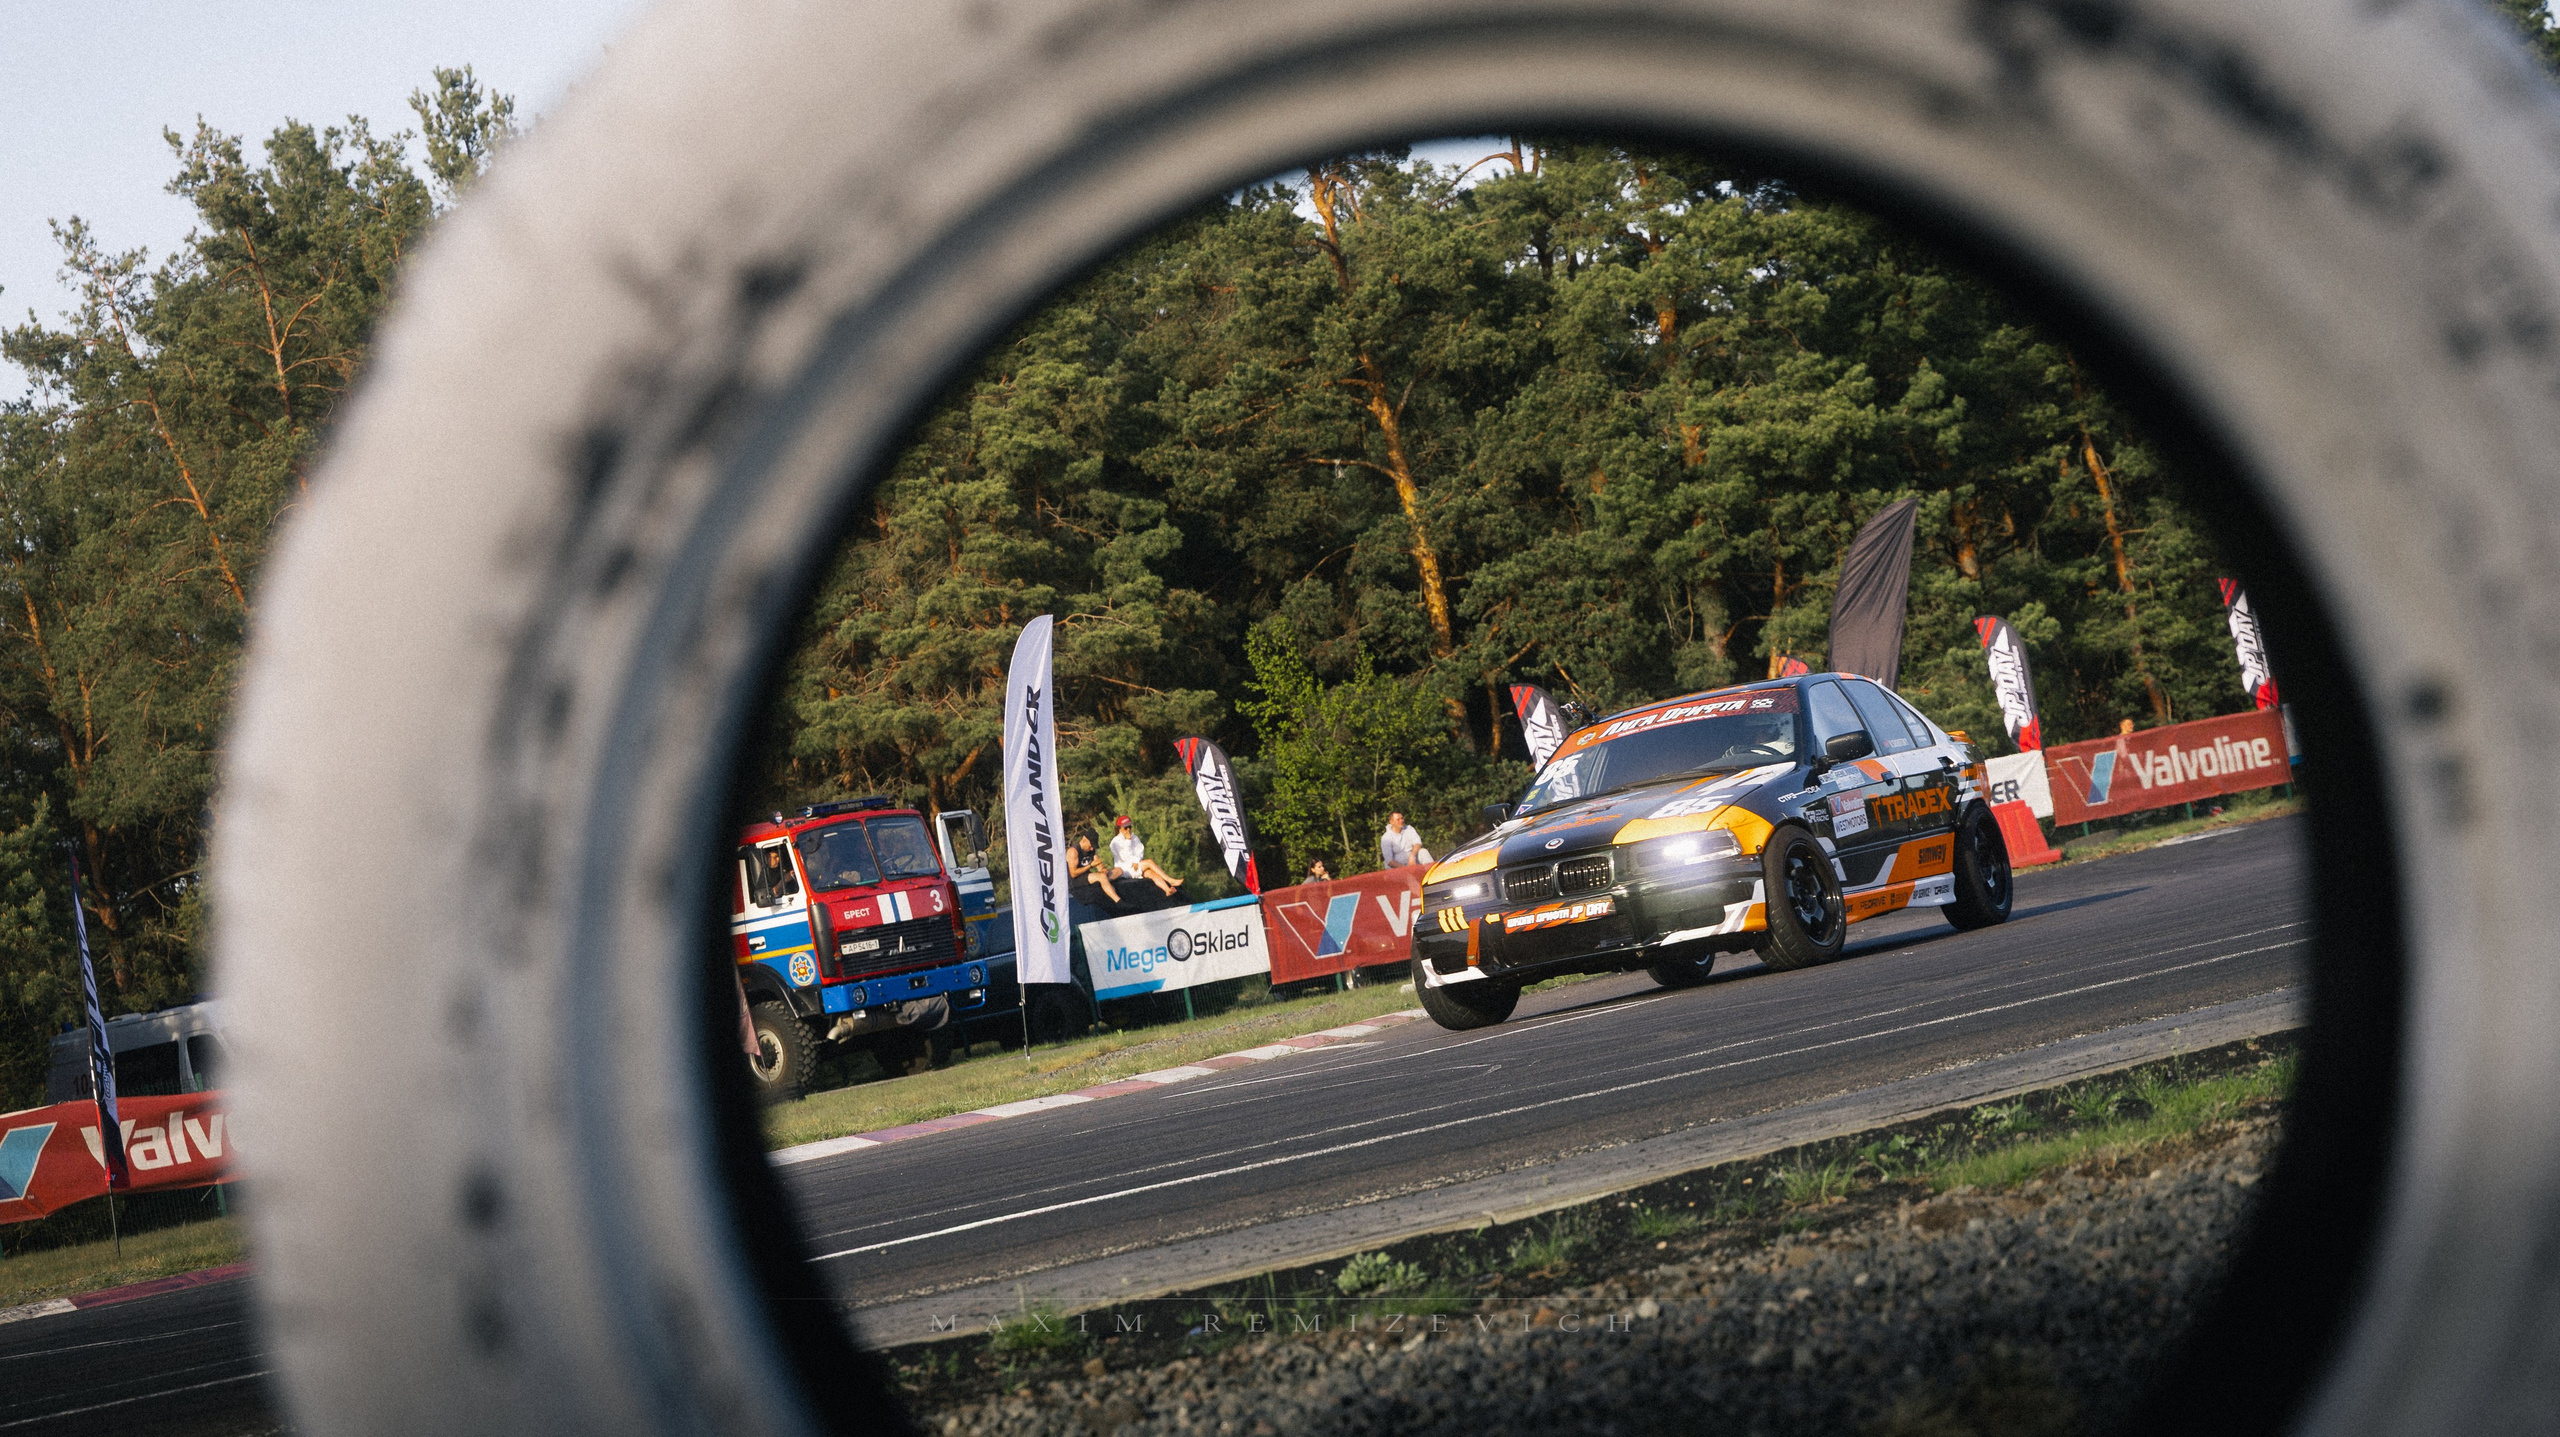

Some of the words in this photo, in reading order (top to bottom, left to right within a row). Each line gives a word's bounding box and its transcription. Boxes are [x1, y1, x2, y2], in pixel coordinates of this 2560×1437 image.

[2129, 735, 2272, 790] Valvoline
[1026, 684, 1060, 944] GRENLANDER
[1881, 786, 1953, 823] TRADEX
[843, 907, 870, 920] БРЕСТ
[929, 889, 944, 912] 3
[1107, 945, 1169, 973] Mega
[1193, 924, 1249, 956] Sklad
